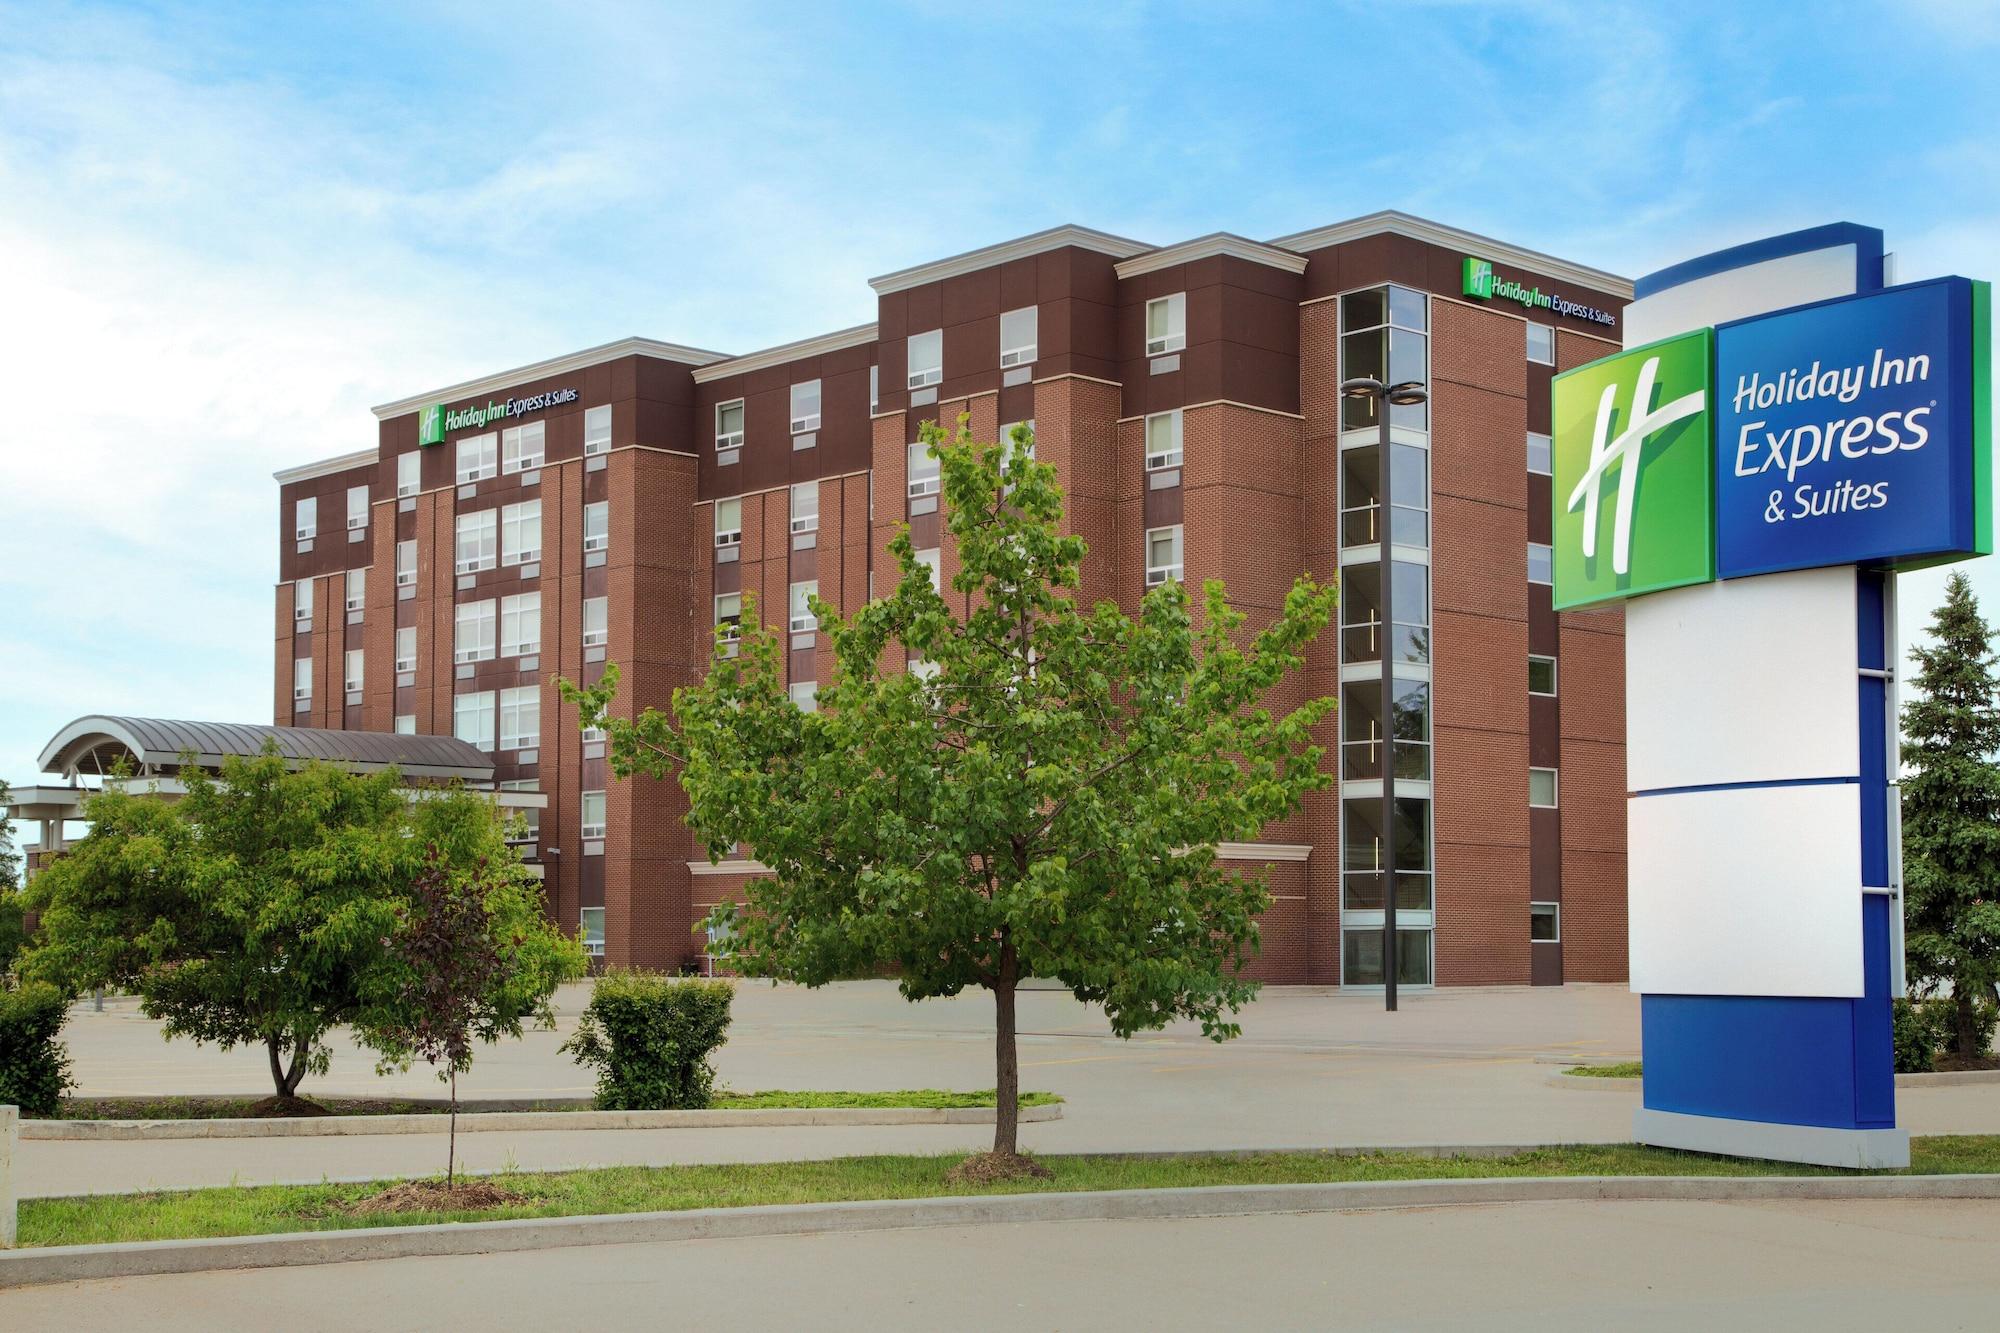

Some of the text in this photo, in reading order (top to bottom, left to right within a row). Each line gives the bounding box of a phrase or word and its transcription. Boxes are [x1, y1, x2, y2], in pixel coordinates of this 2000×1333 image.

[1492, 276, 1616, 326] Holiday Inn Express & Suites
[1733, 348, 1930, 414] Holiday Inn
[445, 389, 577, 431] Holiday Inn Express & Suites
[1733, 406, 1931, 482] Express
[1764, 481, 1889, 523] & Suites
